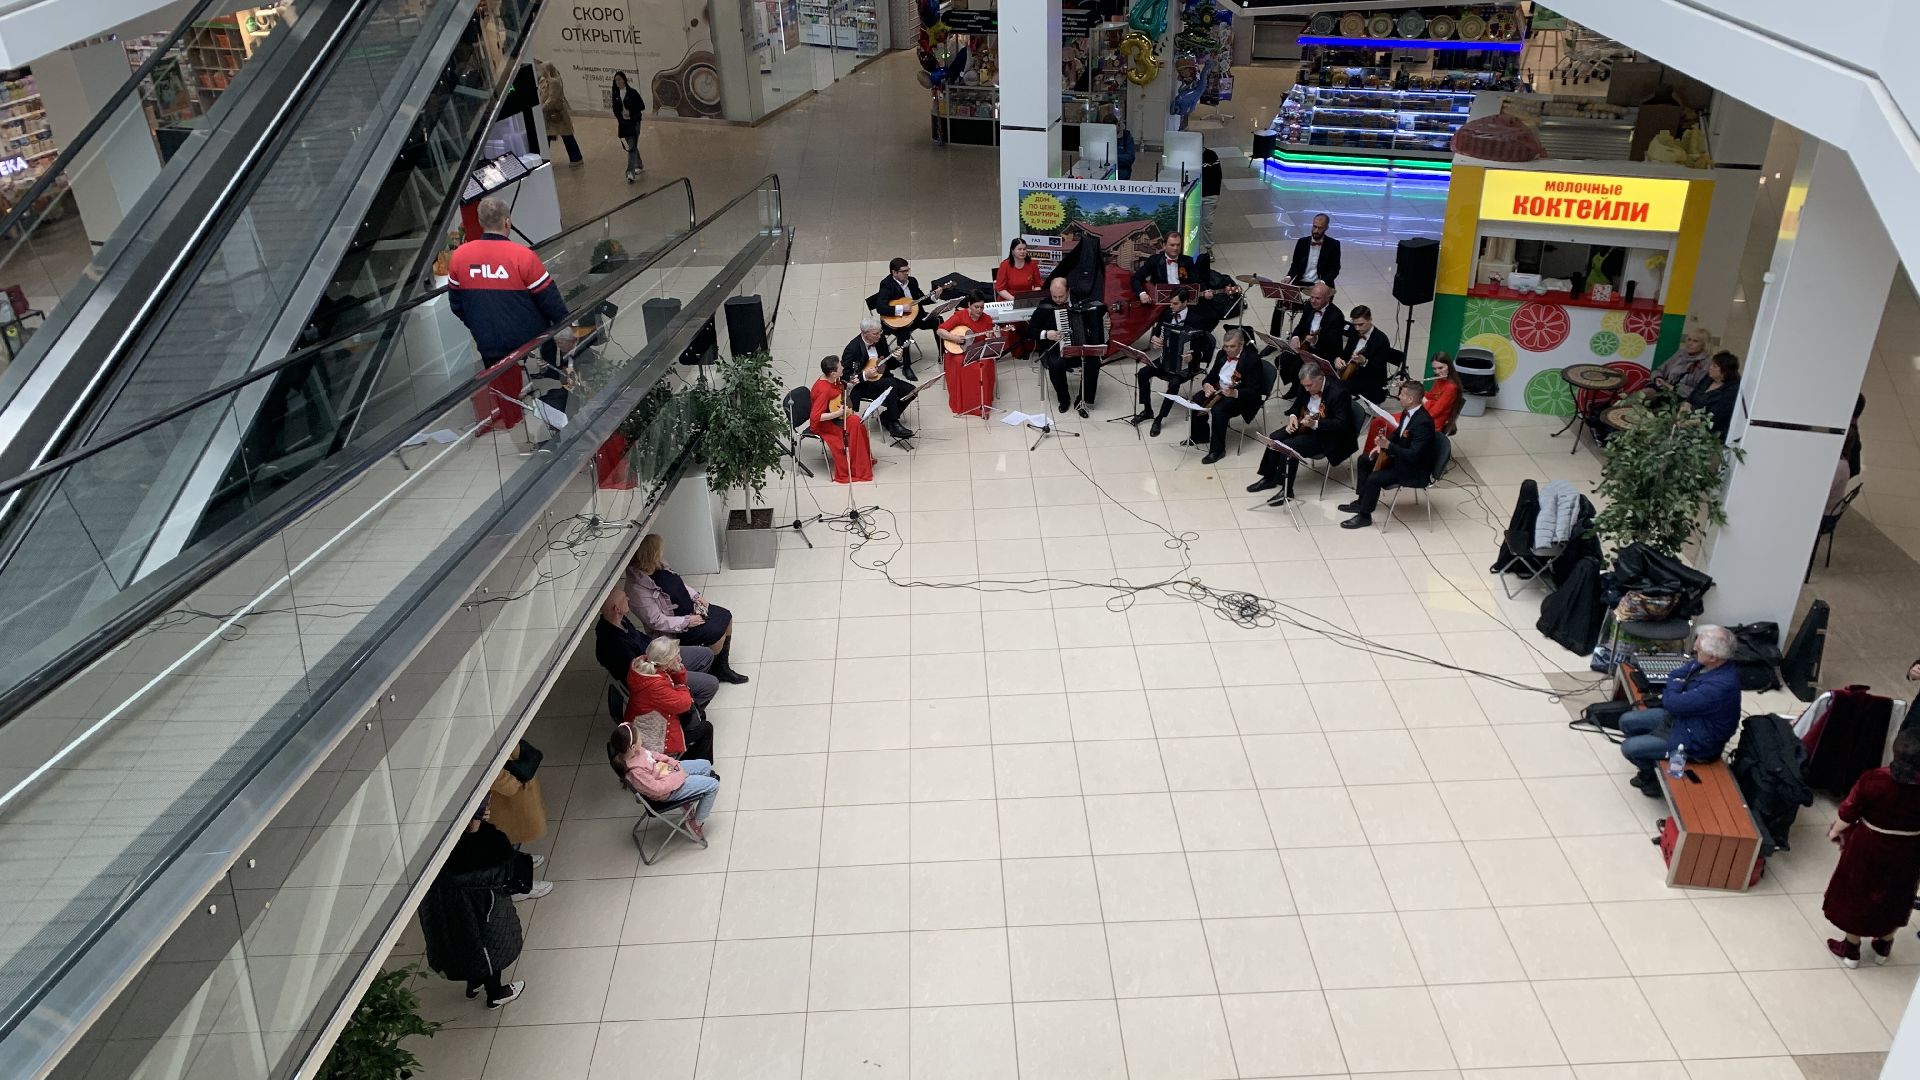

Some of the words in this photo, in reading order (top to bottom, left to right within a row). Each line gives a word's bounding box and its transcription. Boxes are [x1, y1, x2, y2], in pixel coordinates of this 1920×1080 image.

[573, 6, 624, 21] СКОРО
[561, 27, 643, 45] ОТКРЫТИЕ
[1120, 32, 1159, 86] 3
[1022, 180, 1089, 191] КОМФОРТНЫЕ
[1089, 183, 1118, 192] ДОМА
[1128, 185, 1176, 195] ПОСЁЛКЕ!
[1025, 210, 1060, 218] КВАРТИРЫ
[469, 263, 509, 279] FILA
